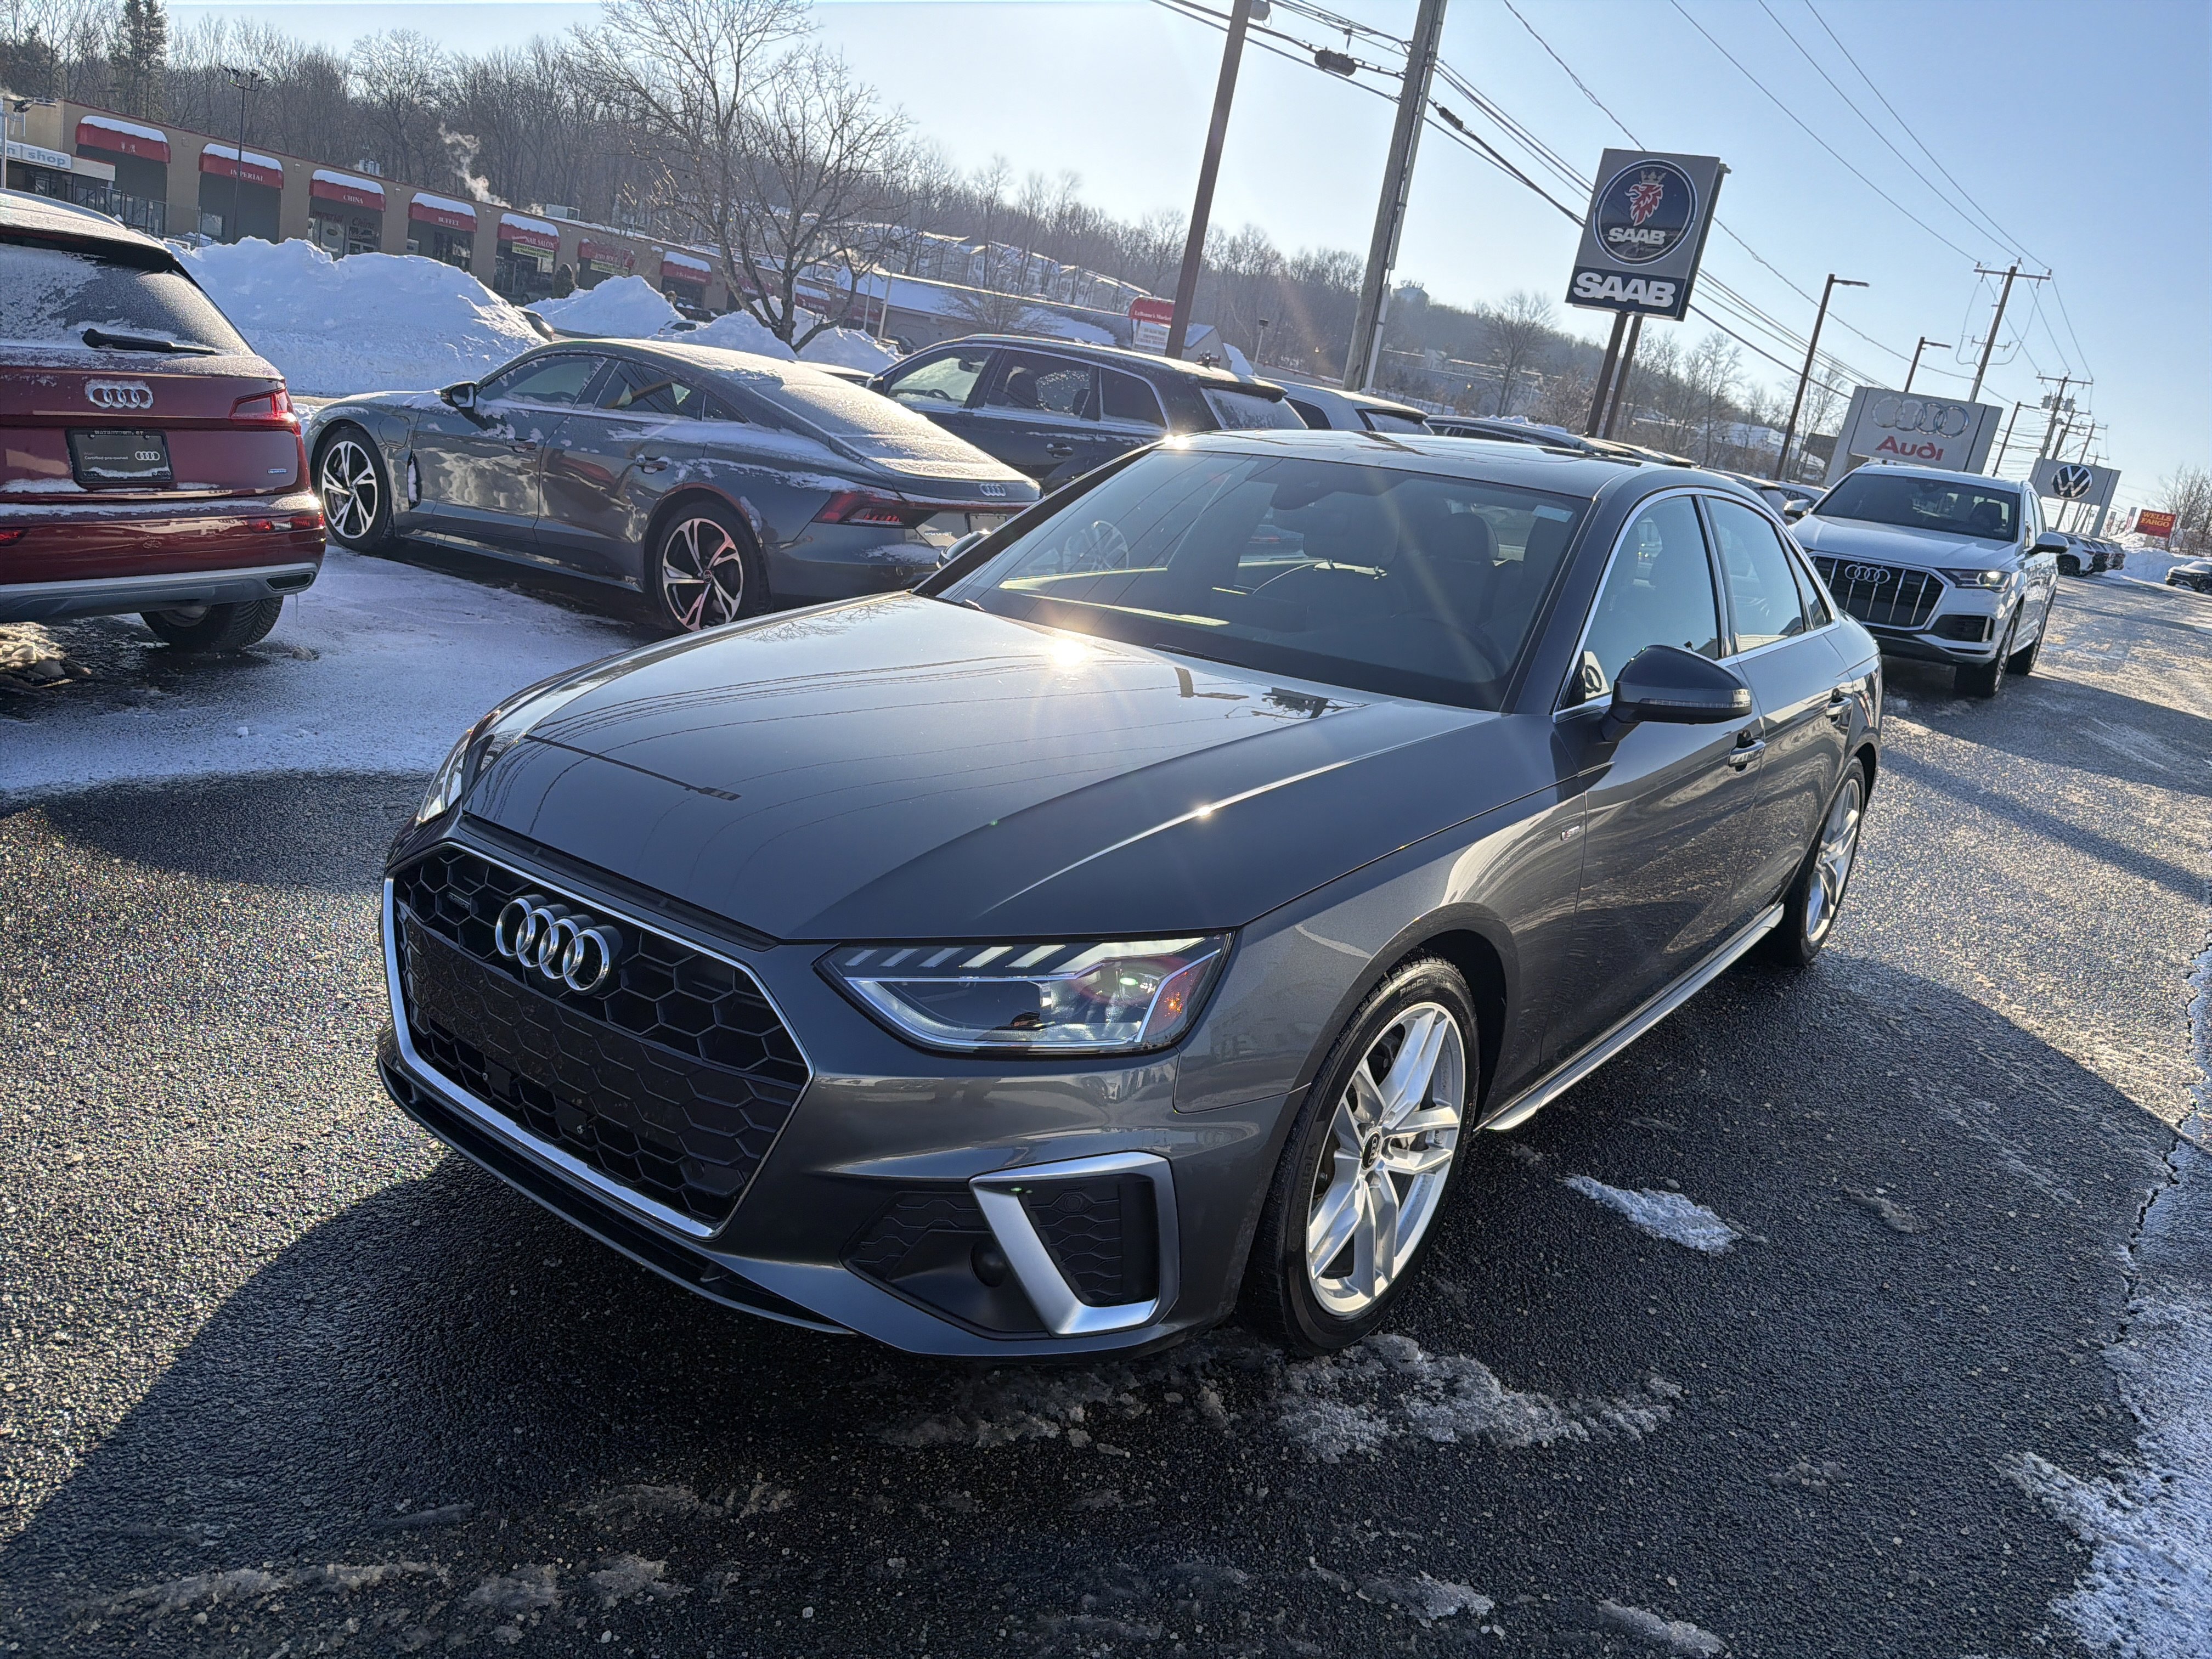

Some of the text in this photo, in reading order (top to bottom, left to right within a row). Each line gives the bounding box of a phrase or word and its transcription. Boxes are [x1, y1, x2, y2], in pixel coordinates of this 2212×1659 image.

[28, 150, 66, 167] shop
[343, 195, 364, 204] CHINA
[525, 236, 537, 245] NAIL
[538, 240, 554, 249] SALON
[1607, 227, 1666, 245] SAAB
[1573, 272, 1676, 308] SAAB
[1875, 436, 1944, 461] Audi
[2141, 517, 2170, 528] FARGO
[2143, 511, 2172, 522] WELLS
